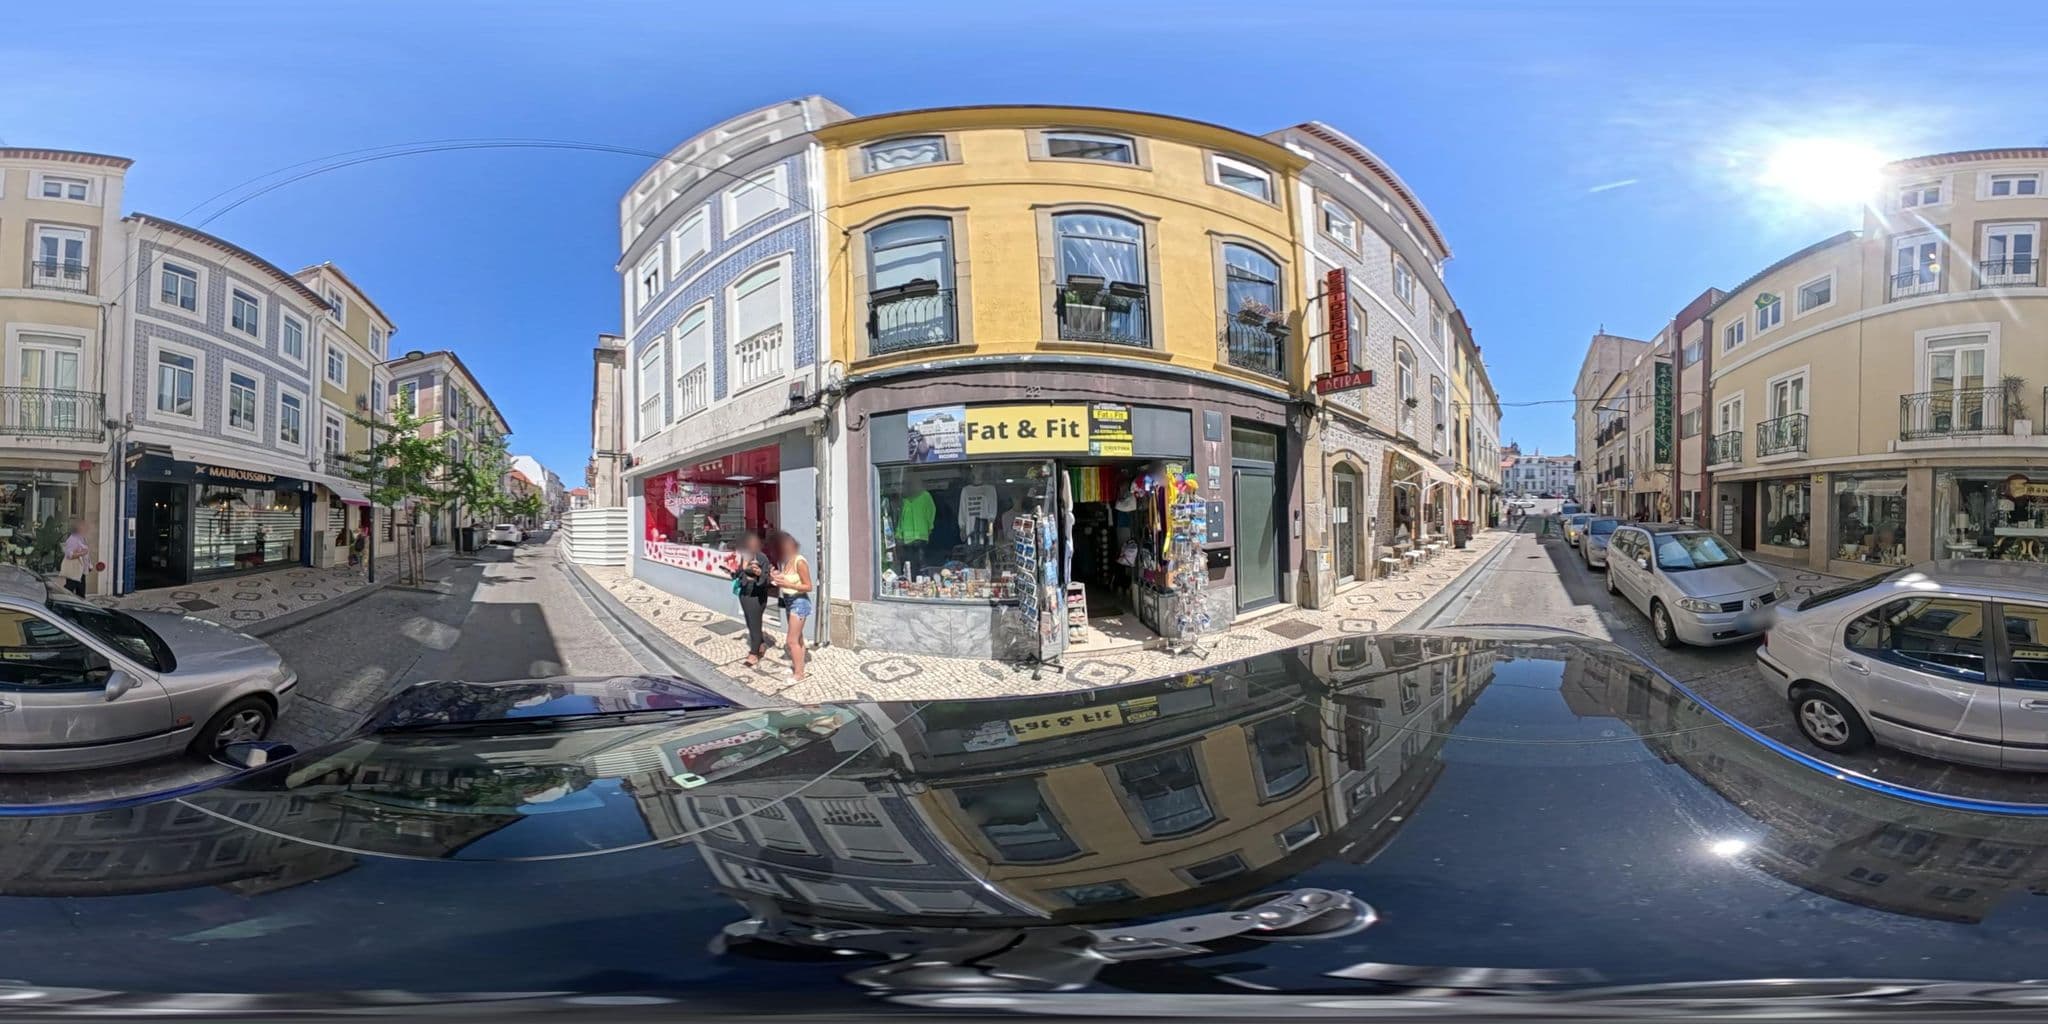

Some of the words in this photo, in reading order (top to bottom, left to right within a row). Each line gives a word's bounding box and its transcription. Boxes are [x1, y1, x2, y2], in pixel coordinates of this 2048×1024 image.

[967, 421, 1009, 441] Fat
[1017, 419, 1037, 439] &
[1046, 418, 1080, 438] Fit
[209, 467, 267, 483] MAUBOUSSIN
